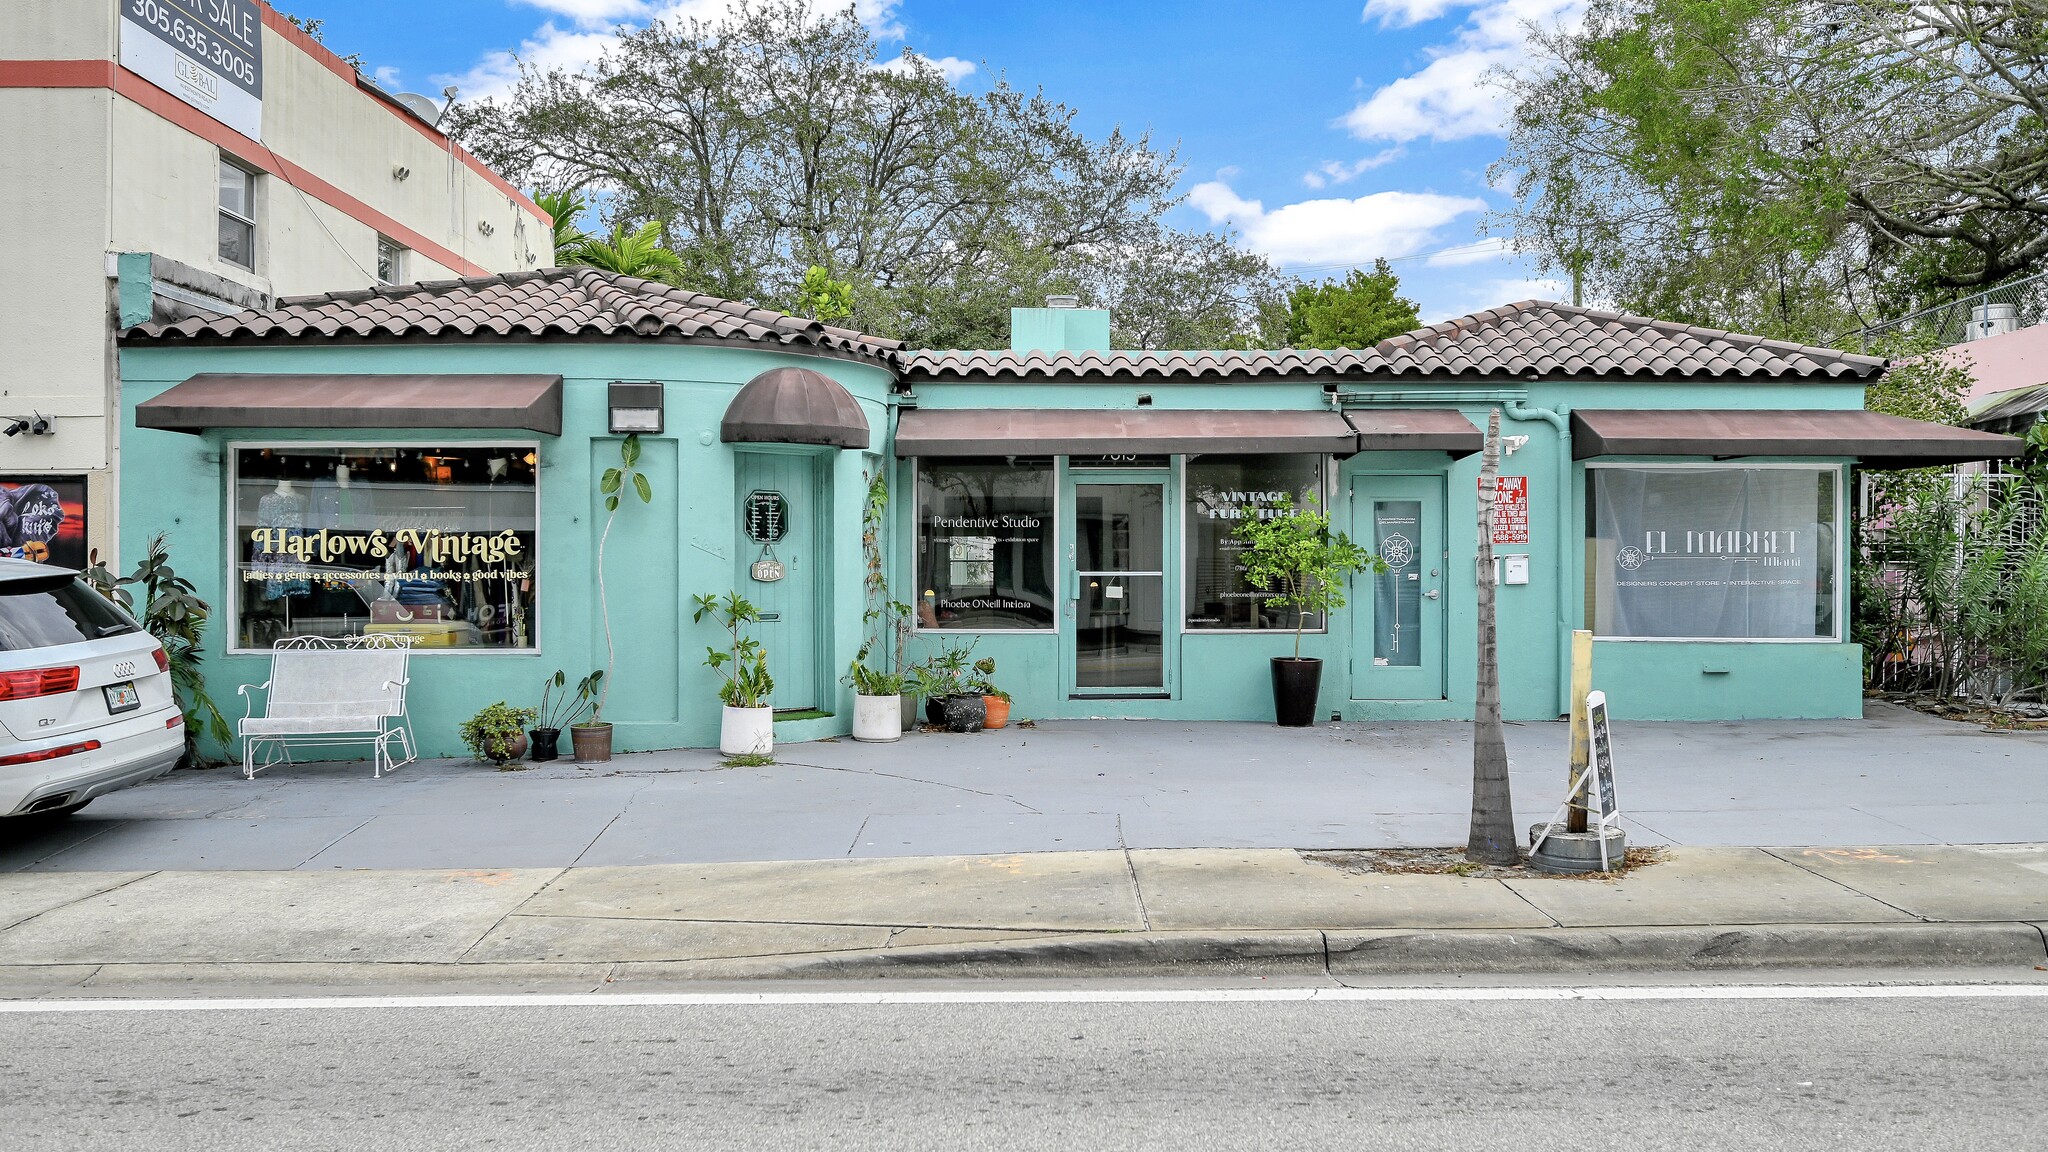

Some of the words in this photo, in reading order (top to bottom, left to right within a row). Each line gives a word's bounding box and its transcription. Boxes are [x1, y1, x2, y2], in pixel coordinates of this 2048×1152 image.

[209, 0, 254, 48] SALE
[132, 0, 255, 86] 305.635.3005
[177, 60, 216, 95] GLOBAL
[1494, 490, 1514, 504] ZONE
[1209, 509, 1300, 519] FURTUE
[934, 515, 999, 528] Pendentive
[1002, 515, 1040, 528] Studio
[251, 528, 388, 563] Harlows
[396, 528, 521, 563] Vintage
[1646, 531, 1677, 553] EL
[1687, 531, 1800, 553] MARKET
[1764, 556, 1801, 566] Miami
[243, 570, 274, 582] ladies
[284, 570, 312, 582] gents
[322, 570, 381, 582] accessories
[392, 570, 419, 582] vinyl
[429, 570, 462, 582] books
[472, 569, 498, 581] good
[499, 569, 529, 582] vibes
[758, 569, 780, 579] OPEN
[940, 599, 971, 609] Phoebe
[972, 599, 1001, 609] O'Neill
[38, 718, 57, 727] Q7
